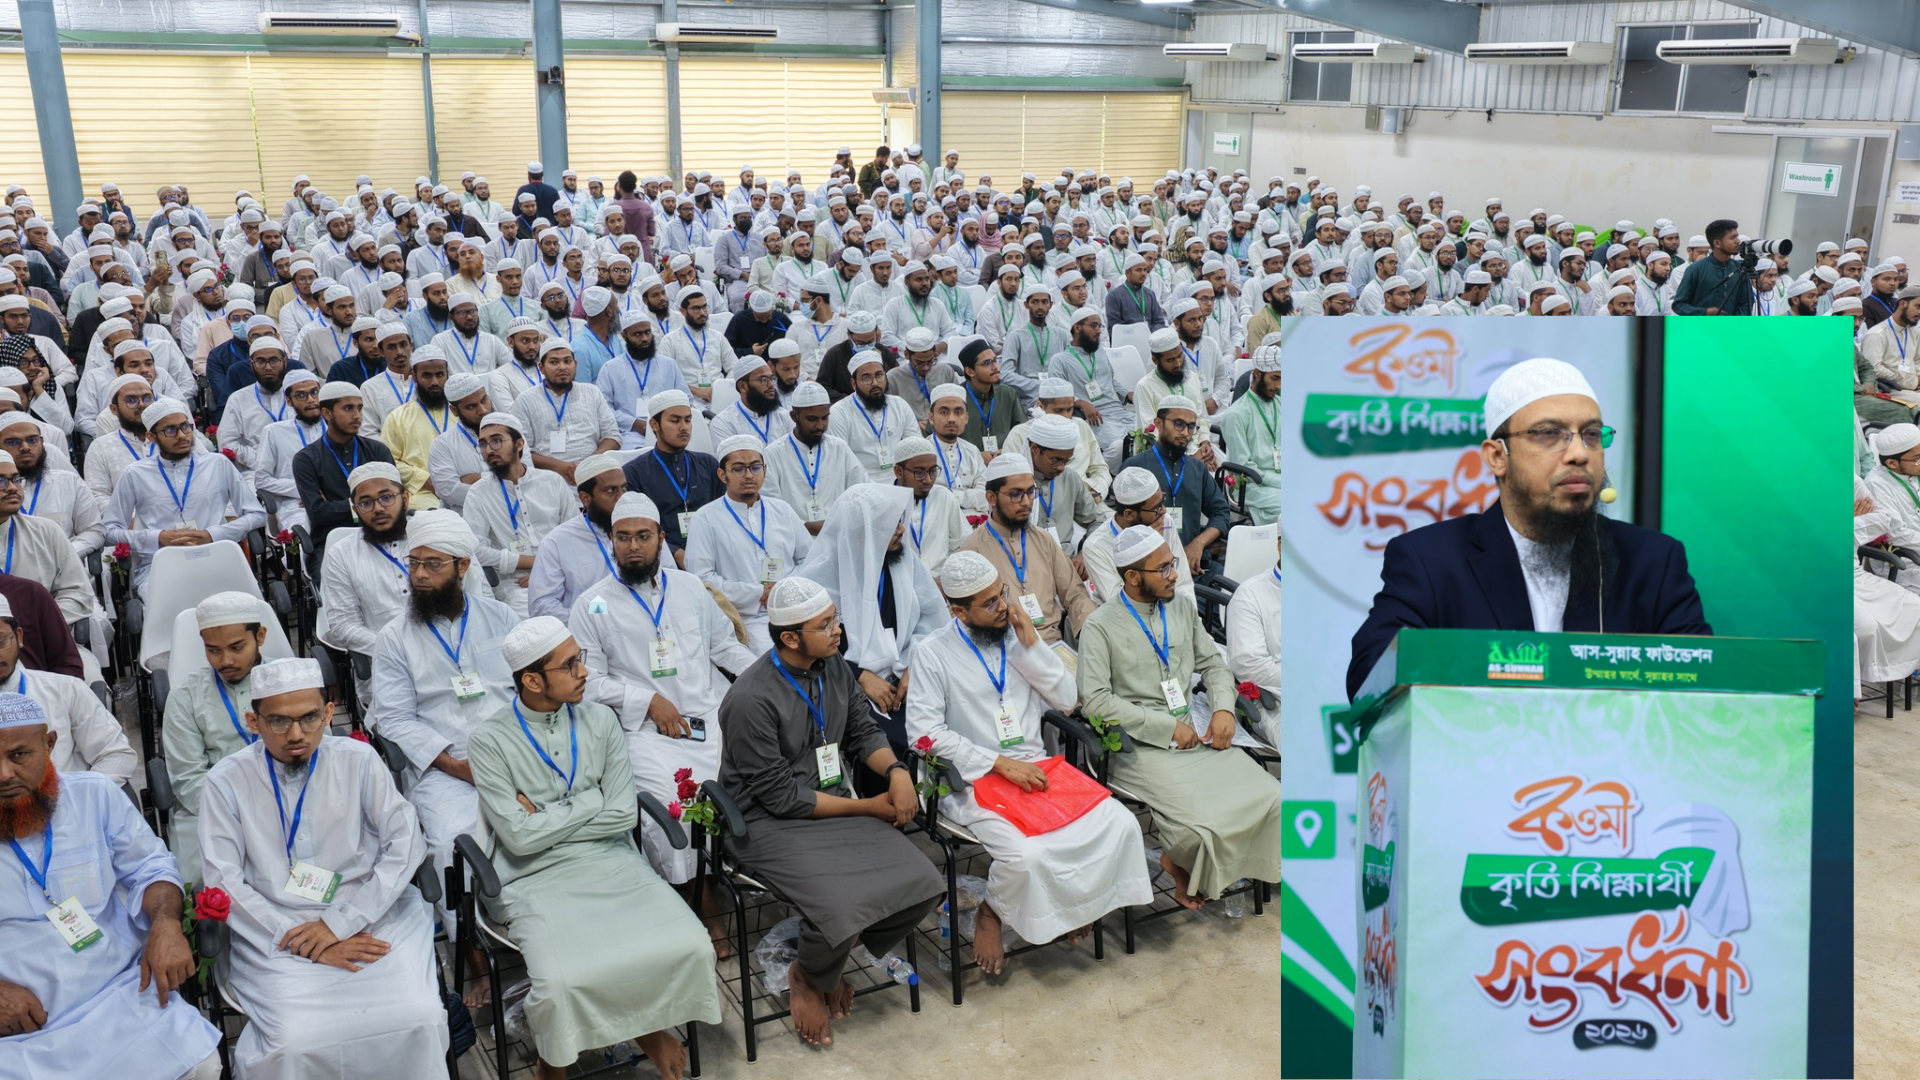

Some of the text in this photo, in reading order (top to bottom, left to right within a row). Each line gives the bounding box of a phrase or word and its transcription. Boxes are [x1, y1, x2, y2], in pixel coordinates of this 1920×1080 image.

[1788, 173, 1822, 182] Washroom
[1326, 400, 1393, 446] কৃতি
[1488, 663, 1544, 674] AS-SUNNAH
[1569, 643, 1713, 664] আস-সুন্নাহ ফাউন্ডেশন
[1507, 775, 1636, 851] কওমী
[1487, 861, 1694, 911] কৃতি শিক্ষার্থী
[1474, 908, 1747, 1028] সংবর্ধনা
[1585, 1023, 1648, 1044] ২০২৬
